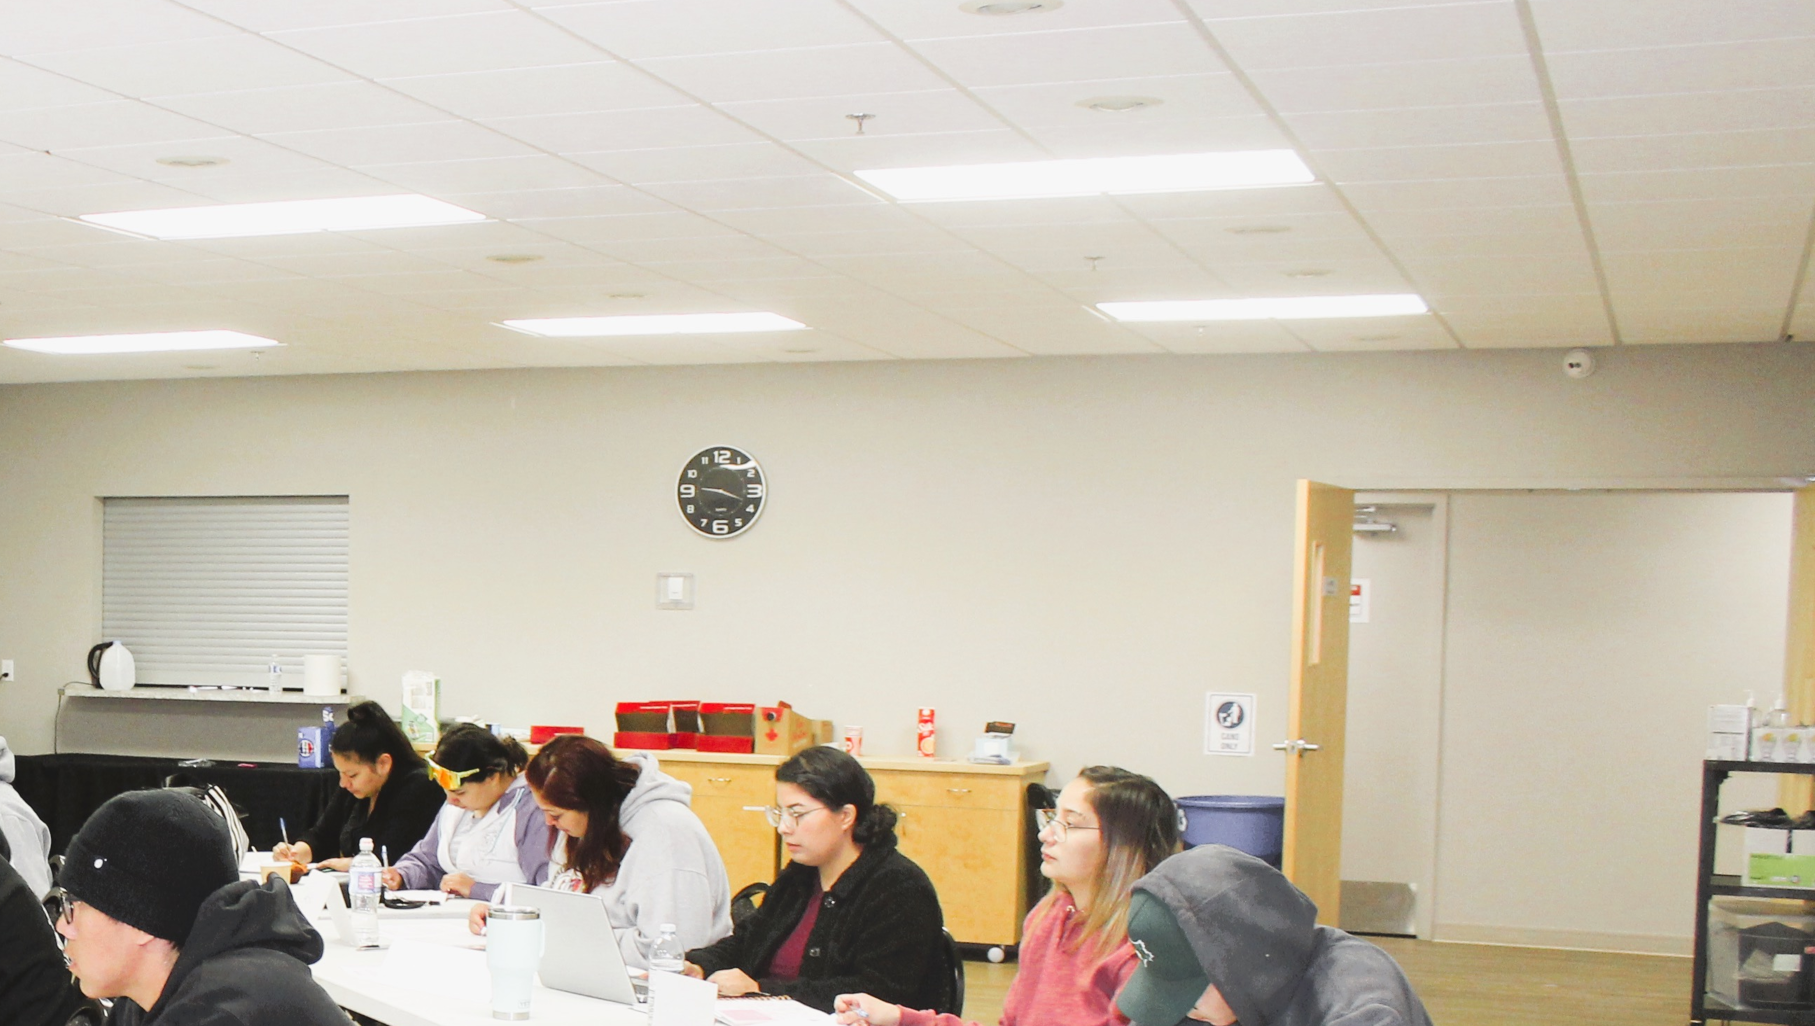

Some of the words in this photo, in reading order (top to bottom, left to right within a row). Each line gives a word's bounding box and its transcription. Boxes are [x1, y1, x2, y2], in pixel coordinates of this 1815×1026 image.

[701, 456, 709, 465] 11
[713, 450, 731, 464] 12
[736, 456, 741, 465] 1
[687, 469, 697, 478] 10
[747, 469, 755, 478] 2
[680, 484, 695, 498] 9
[747, 484, 763, 498] 3
[687, 504, 695, 514] 8
[746, 504, 755, 513] 4
[700, 519, 708, 527] 7
[712, 520, 729, 533] 6
[734, 518, 742, 527] 5
